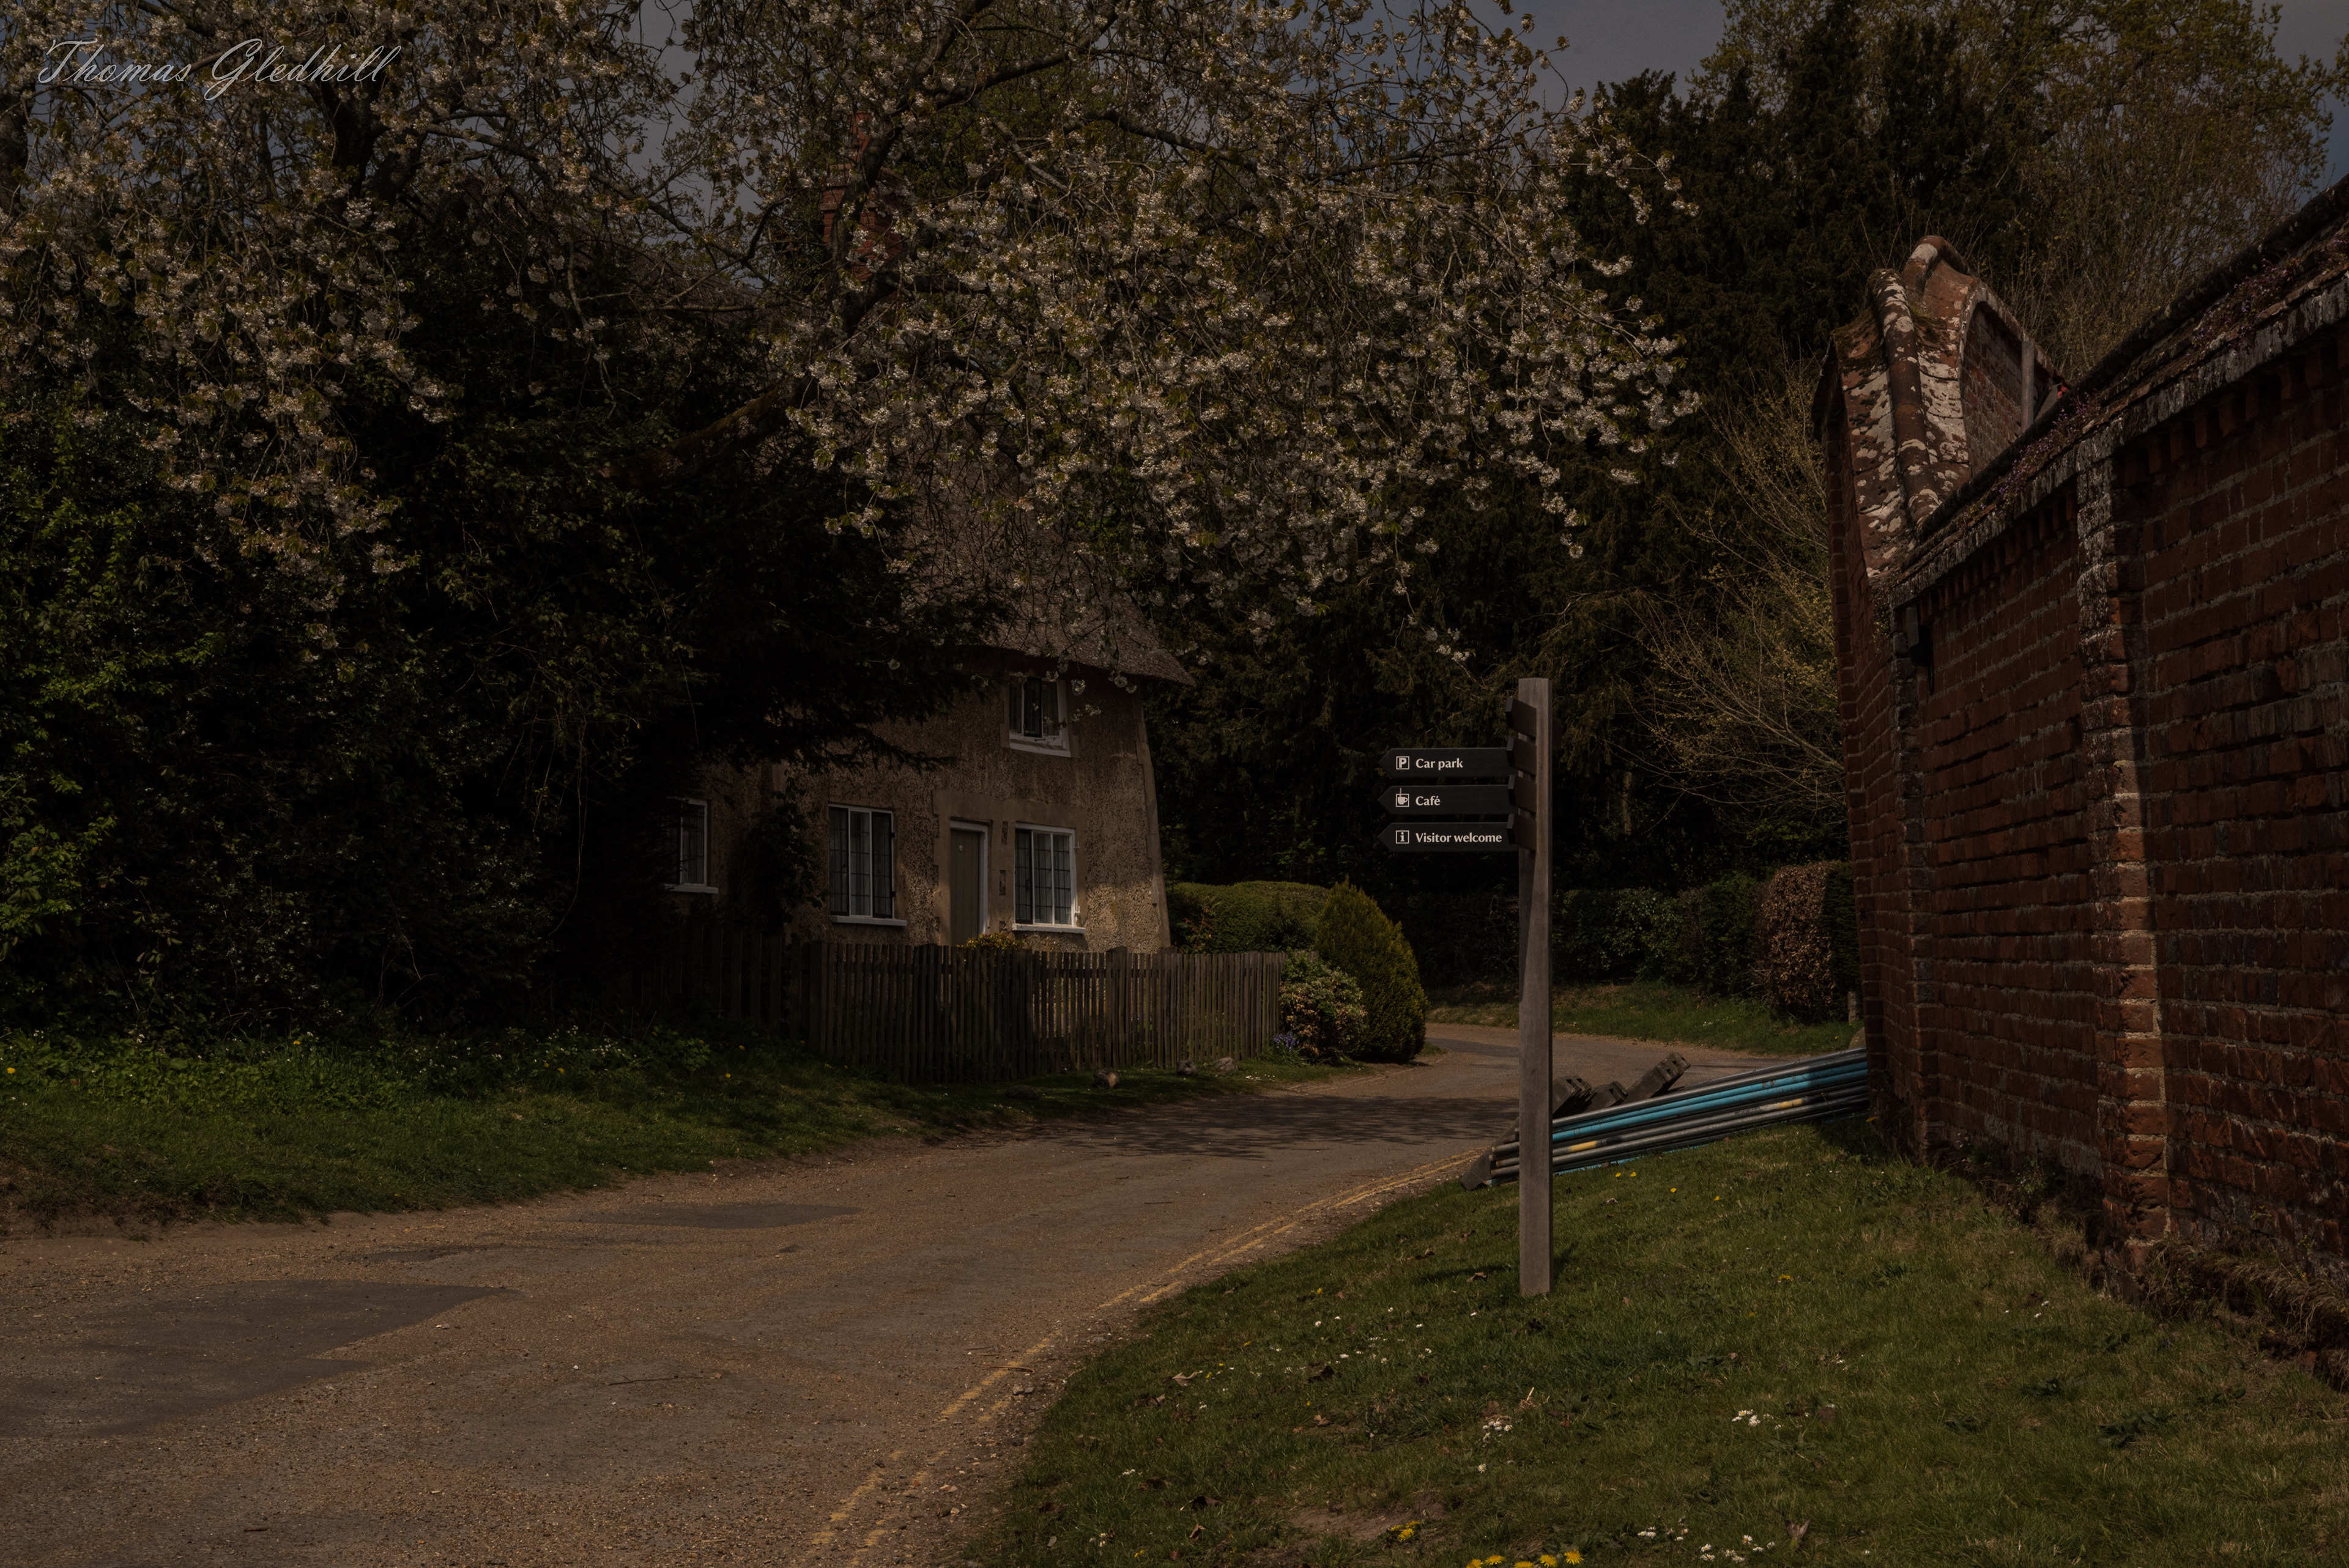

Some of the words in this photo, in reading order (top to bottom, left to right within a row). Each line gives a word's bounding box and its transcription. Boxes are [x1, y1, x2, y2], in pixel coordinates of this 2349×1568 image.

[1398, 756, 1408, 769] P
[1415, 758, 1436, 769] Car
[1438, 757, 1463, 771] park
[1415, 794, 1441, 807] Café
[1415, 832, 1452, 843] Visitor
[1453, 832, 1502, 843] welcome
